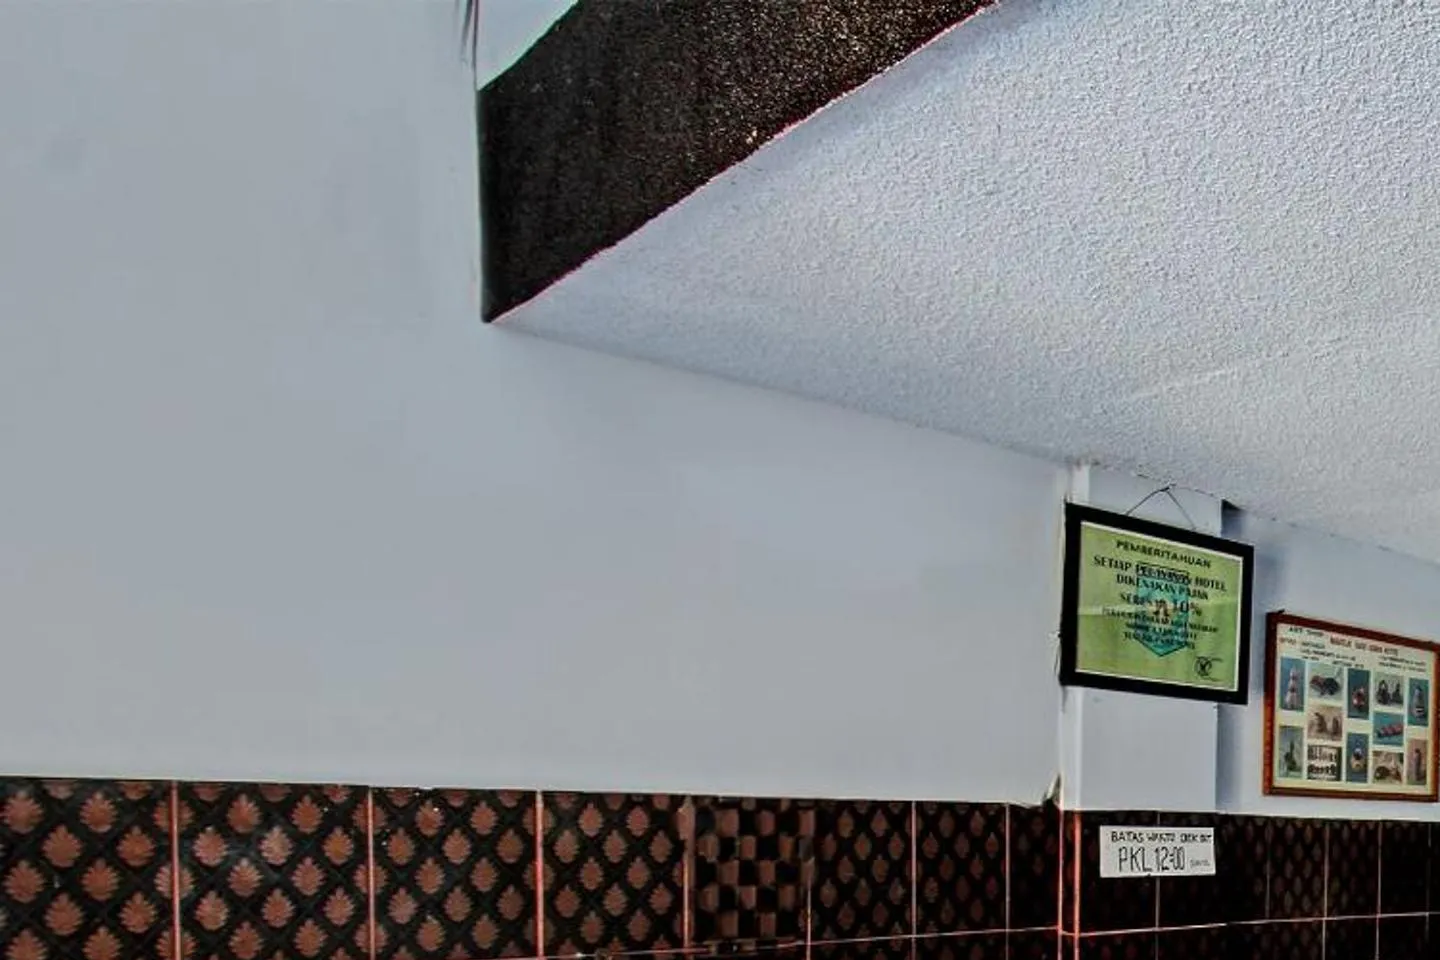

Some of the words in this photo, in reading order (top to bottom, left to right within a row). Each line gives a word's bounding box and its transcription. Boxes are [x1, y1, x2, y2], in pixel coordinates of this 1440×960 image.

[1115, 540, 1212, 568] PEMBERITAHUAN
[1093, 554, 1132, 572] SETIAP
[1194, 575, 1227, 592] HOTEL
[1110, 830, 1145, 843] BATAS
[1118, 846, 1153, 873] PKL
